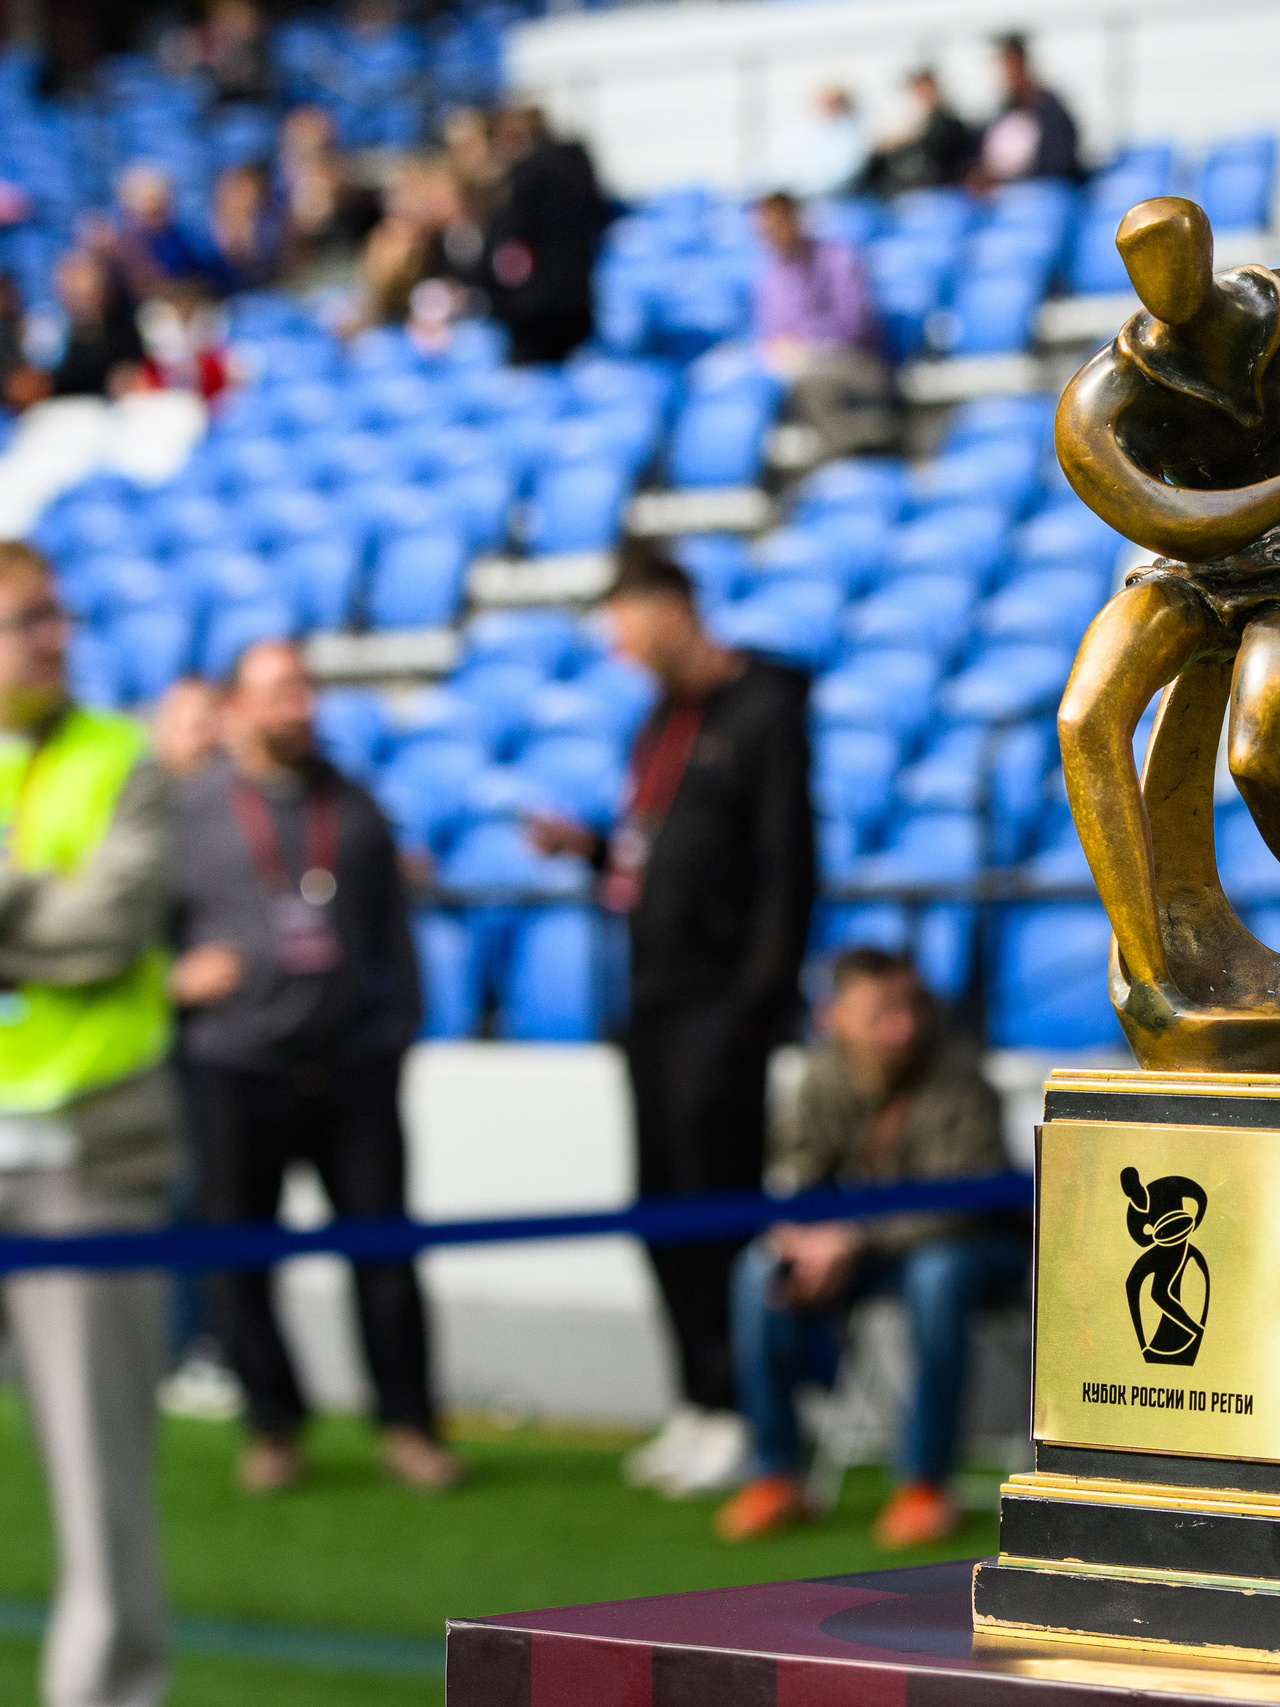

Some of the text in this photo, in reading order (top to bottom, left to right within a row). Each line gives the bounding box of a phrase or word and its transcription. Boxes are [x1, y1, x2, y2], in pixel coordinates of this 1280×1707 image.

[1082, 1382, 1253, 1415] КУБОК РОССИИ ПО РЕГБИ
